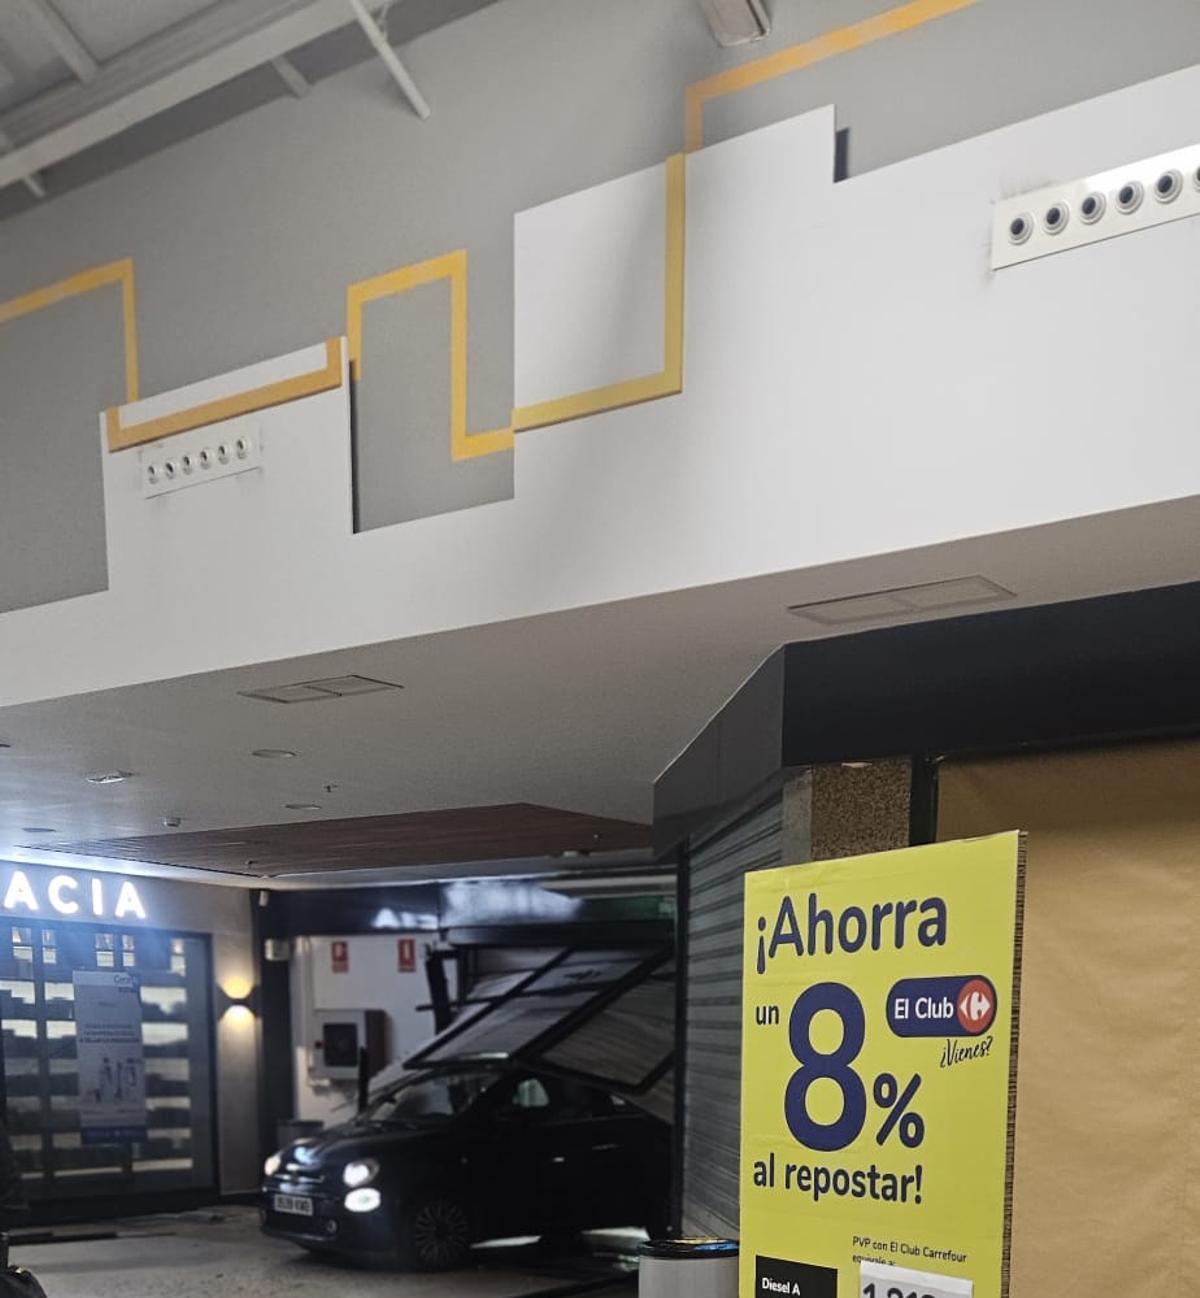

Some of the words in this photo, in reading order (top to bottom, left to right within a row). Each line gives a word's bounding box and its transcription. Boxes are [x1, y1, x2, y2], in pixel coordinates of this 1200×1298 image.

[755, 893, 947, 974] ¡Ahorra
[755, 1001, 779, 1025] un
[894, 998, 909, 1019] El
[915, 997, 954, 1019] Club
[940, 1036, 993, 1068] ¿Vienes?
[754, 1152, 775, 1188] al
[785, 1160, 922, 1204] repostar!
[853, 1236, 870, 1247] PVP
[873, 1241, 887, 1251] con
[890, 1242, 898, 1252] El
[901, 1244, 920, 1255] Club
[923, 1247, 967, 1262] Carrefour
[762, 1277, 790, 1293] Diesel
[792, 1283, 801, 1296] A
